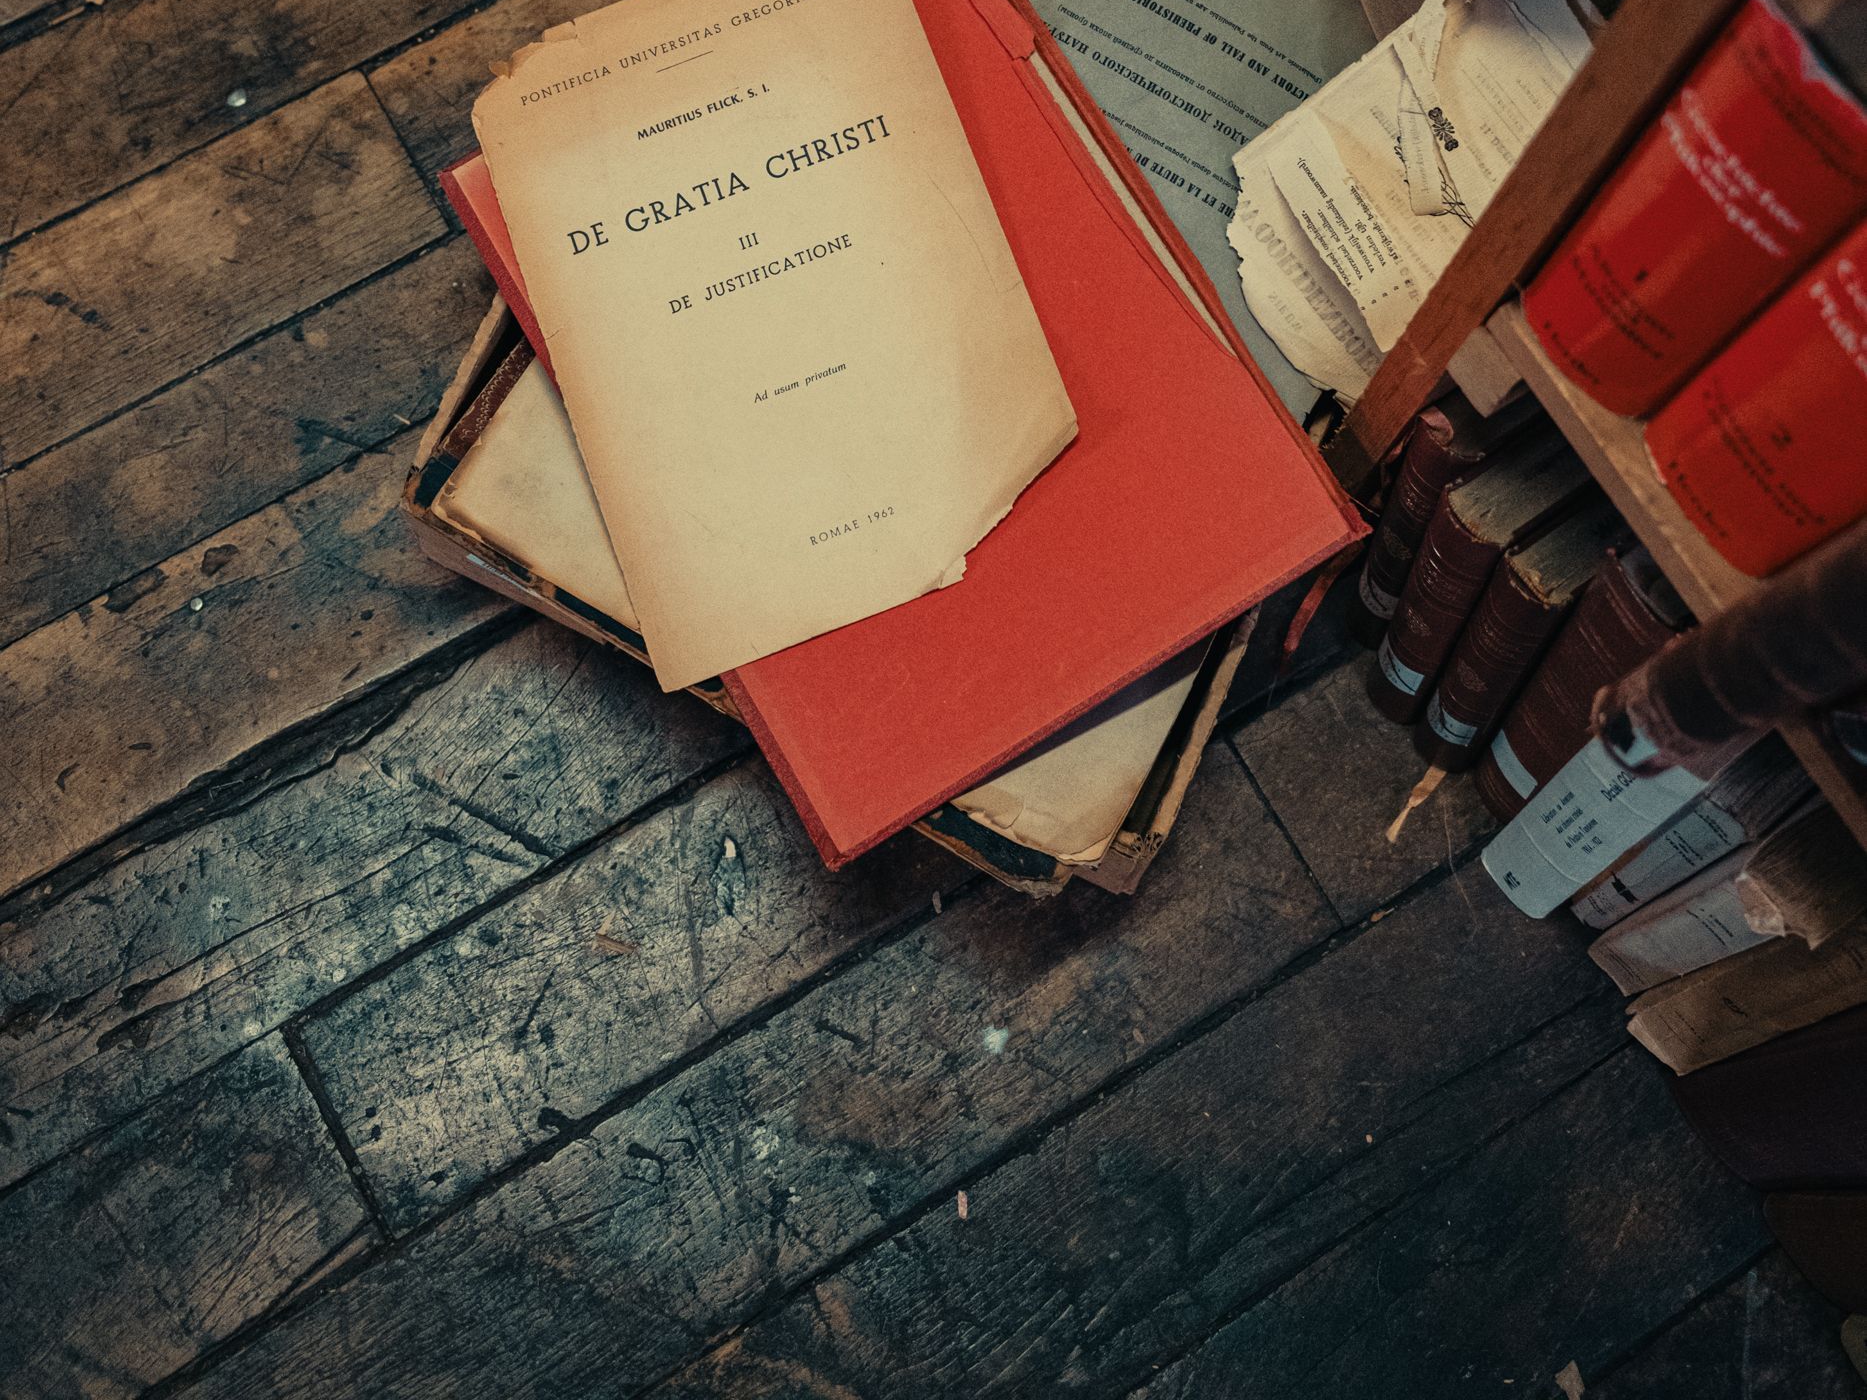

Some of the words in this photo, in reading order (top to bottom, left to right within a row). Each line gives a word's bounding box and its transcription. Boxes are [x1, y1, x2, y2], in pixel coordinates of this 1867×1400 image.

[1195, 2, 1208, 12] Age
[1202, 32, 1217, 44] OF
[1246, 32, 1257, 42] the
[1259, 40, 1274, 53] from
[1143, 53, 1154, 61] до
[1220, 41, 1245, 62] FALL
[1275, 50, 1286, 60] Art
[520, 65, 611, 106] PONTIFICIA
[618, 23, 721, 68] UNIVERSITAS
[1247, 58, 1270, 76] AND
[1091, 51, 1212, 123] ДОИСТОРИЧЕСКОГО
[1195, 82, 1205, 90] от
[637, 108, 702, 140] MAURITIUS
[746, 88, 757, 98] S.
[761, 83, 769, 92] I.
[1132, 152, 1149, 167] DU
[566, 221, 608, 255] DE
[624, 172, 750, 232] GRATIA
[765, 114, 890, 178] CHRISTI
[1149, 161, 1185, 187] CHUTE
[1186, 182, 1201, 197] LA
[1201, 193, 1217, 207] ET
[738, 232, 759, 250] III
[1365, 234, 1386, 267] verleden
[1372, 221, 1398, 260] afwijkende
[1337, 244, 1363, 280] voorzetsel
[1347, 233, 1374, 273] vrouwelijk
[668, 294, 692, 314] DE
[704, 233, 852, 300] JUSTIFICATIONE
[1326, 251, 1351, 287] voorzetsel
[754, 389, 768, 403] Ad
[773, 381, 799, 395] usum
[804, 363, 846, 386] privatum
[809, 519, 859, 545] ROMAE
[867, 506, 894, 523] 1962
